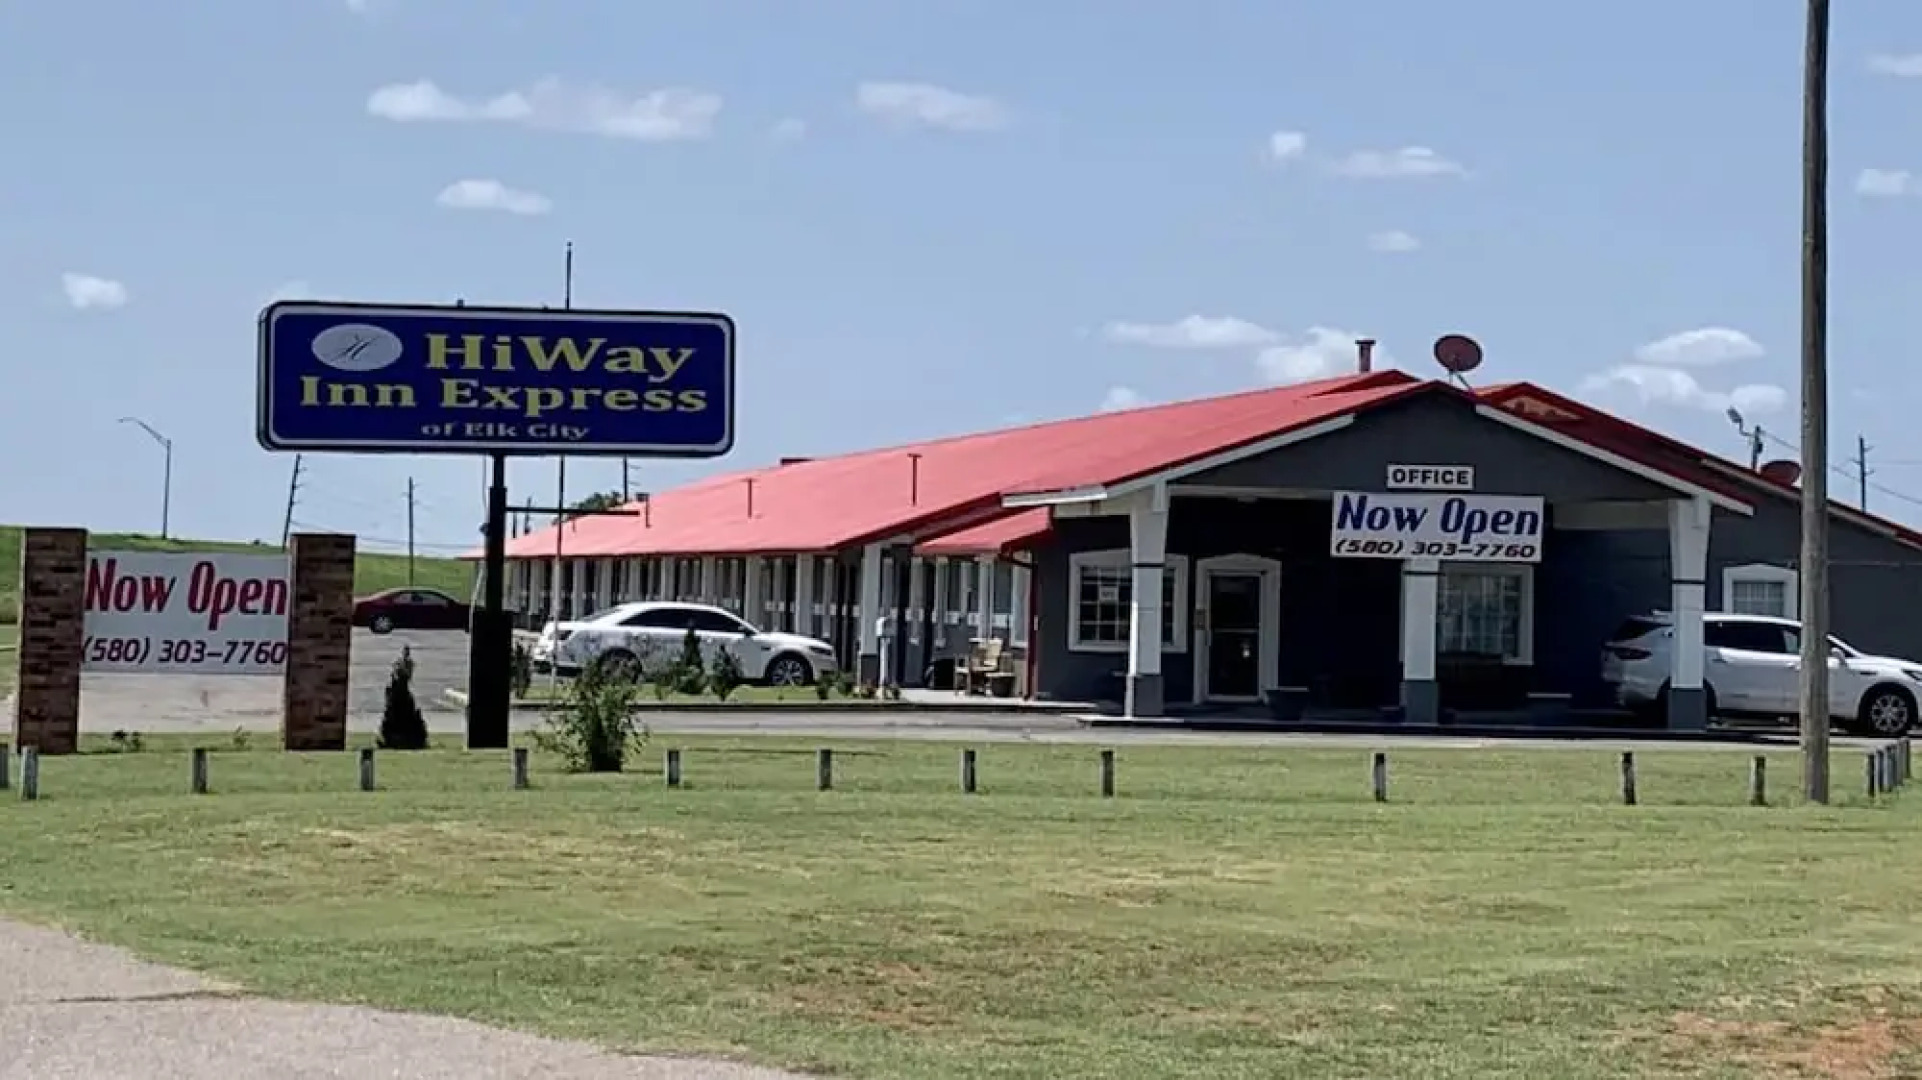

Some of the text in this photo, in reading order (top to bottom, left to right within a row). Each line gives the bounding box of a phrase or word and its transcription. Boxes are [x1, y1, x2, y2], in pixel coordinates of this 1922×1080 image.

[425, 333, 695, 382] HiWay
[300, 375, 707, 417] Inn Express
[421, 422, 590, 440] of Elk City
[1392, 468, 1470, 485] OFFICE
[1337, 495, 1539, 544] Now Open
[1336, 539, 1403, 553] (580)
[86, 558, 286, 630] Now Open
[82, 635, 150, 664] (580)
